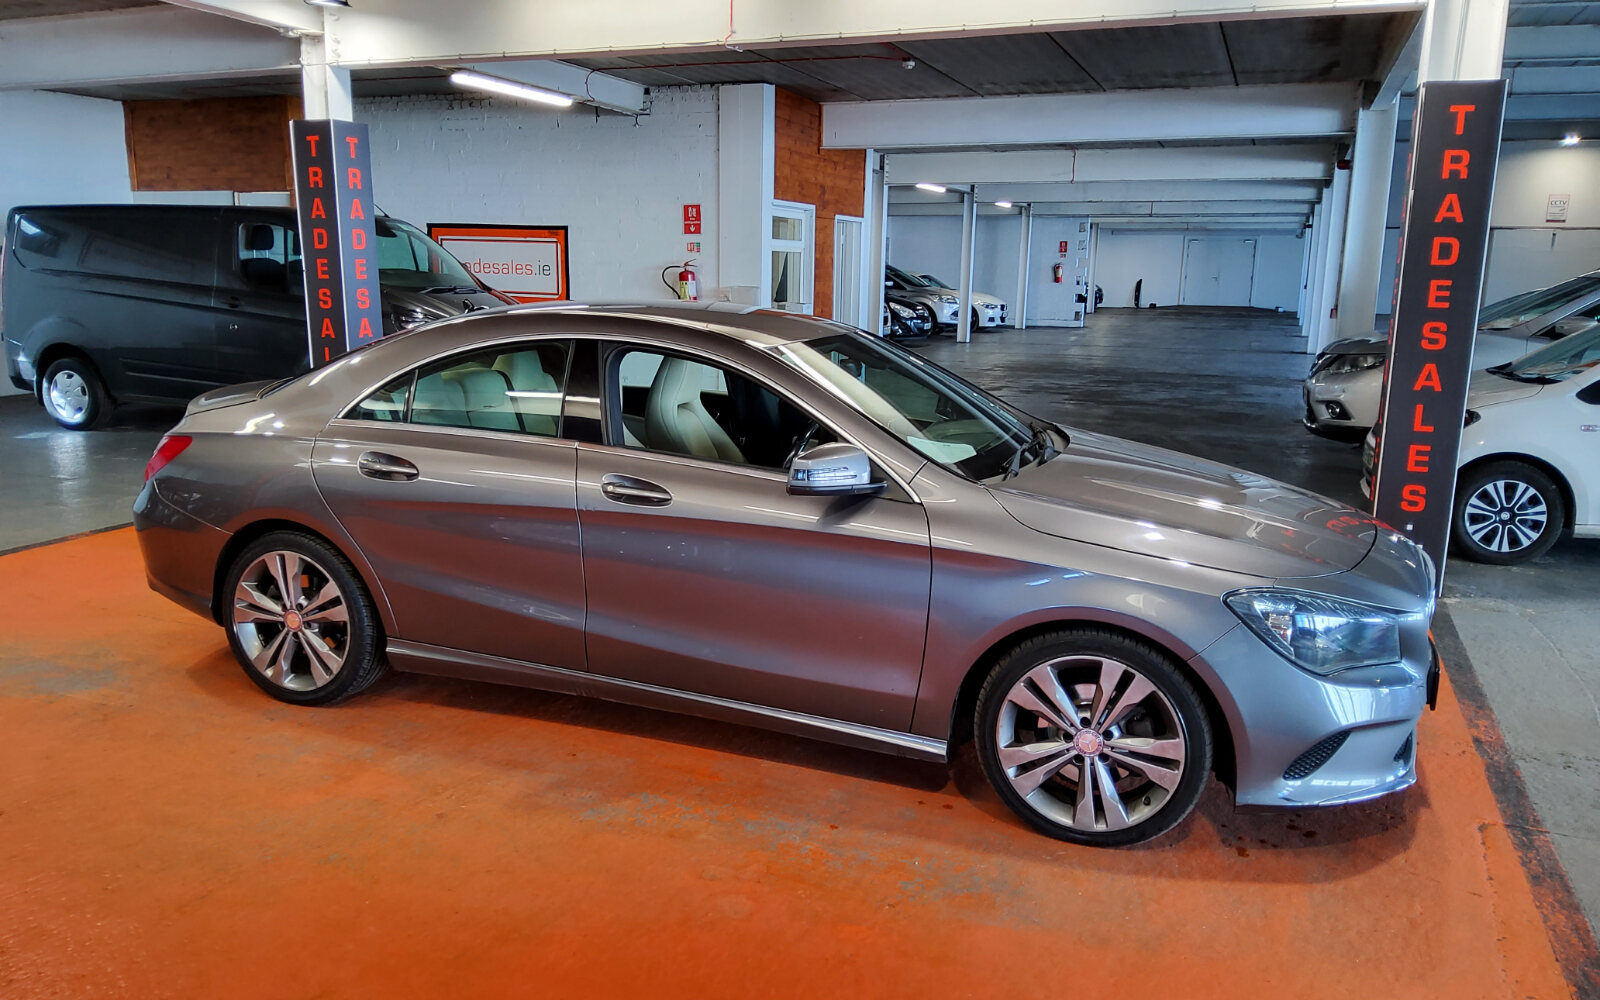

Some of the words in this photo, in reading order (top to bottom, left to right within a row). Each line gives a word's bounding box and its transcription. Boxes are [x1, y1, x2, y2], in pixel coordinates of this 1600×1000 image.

[306, 135, 336, 362] TRADESA
[345, 136, 374, 339] TRADESA
[1400, 104, 1476, 512] TRADESALES
